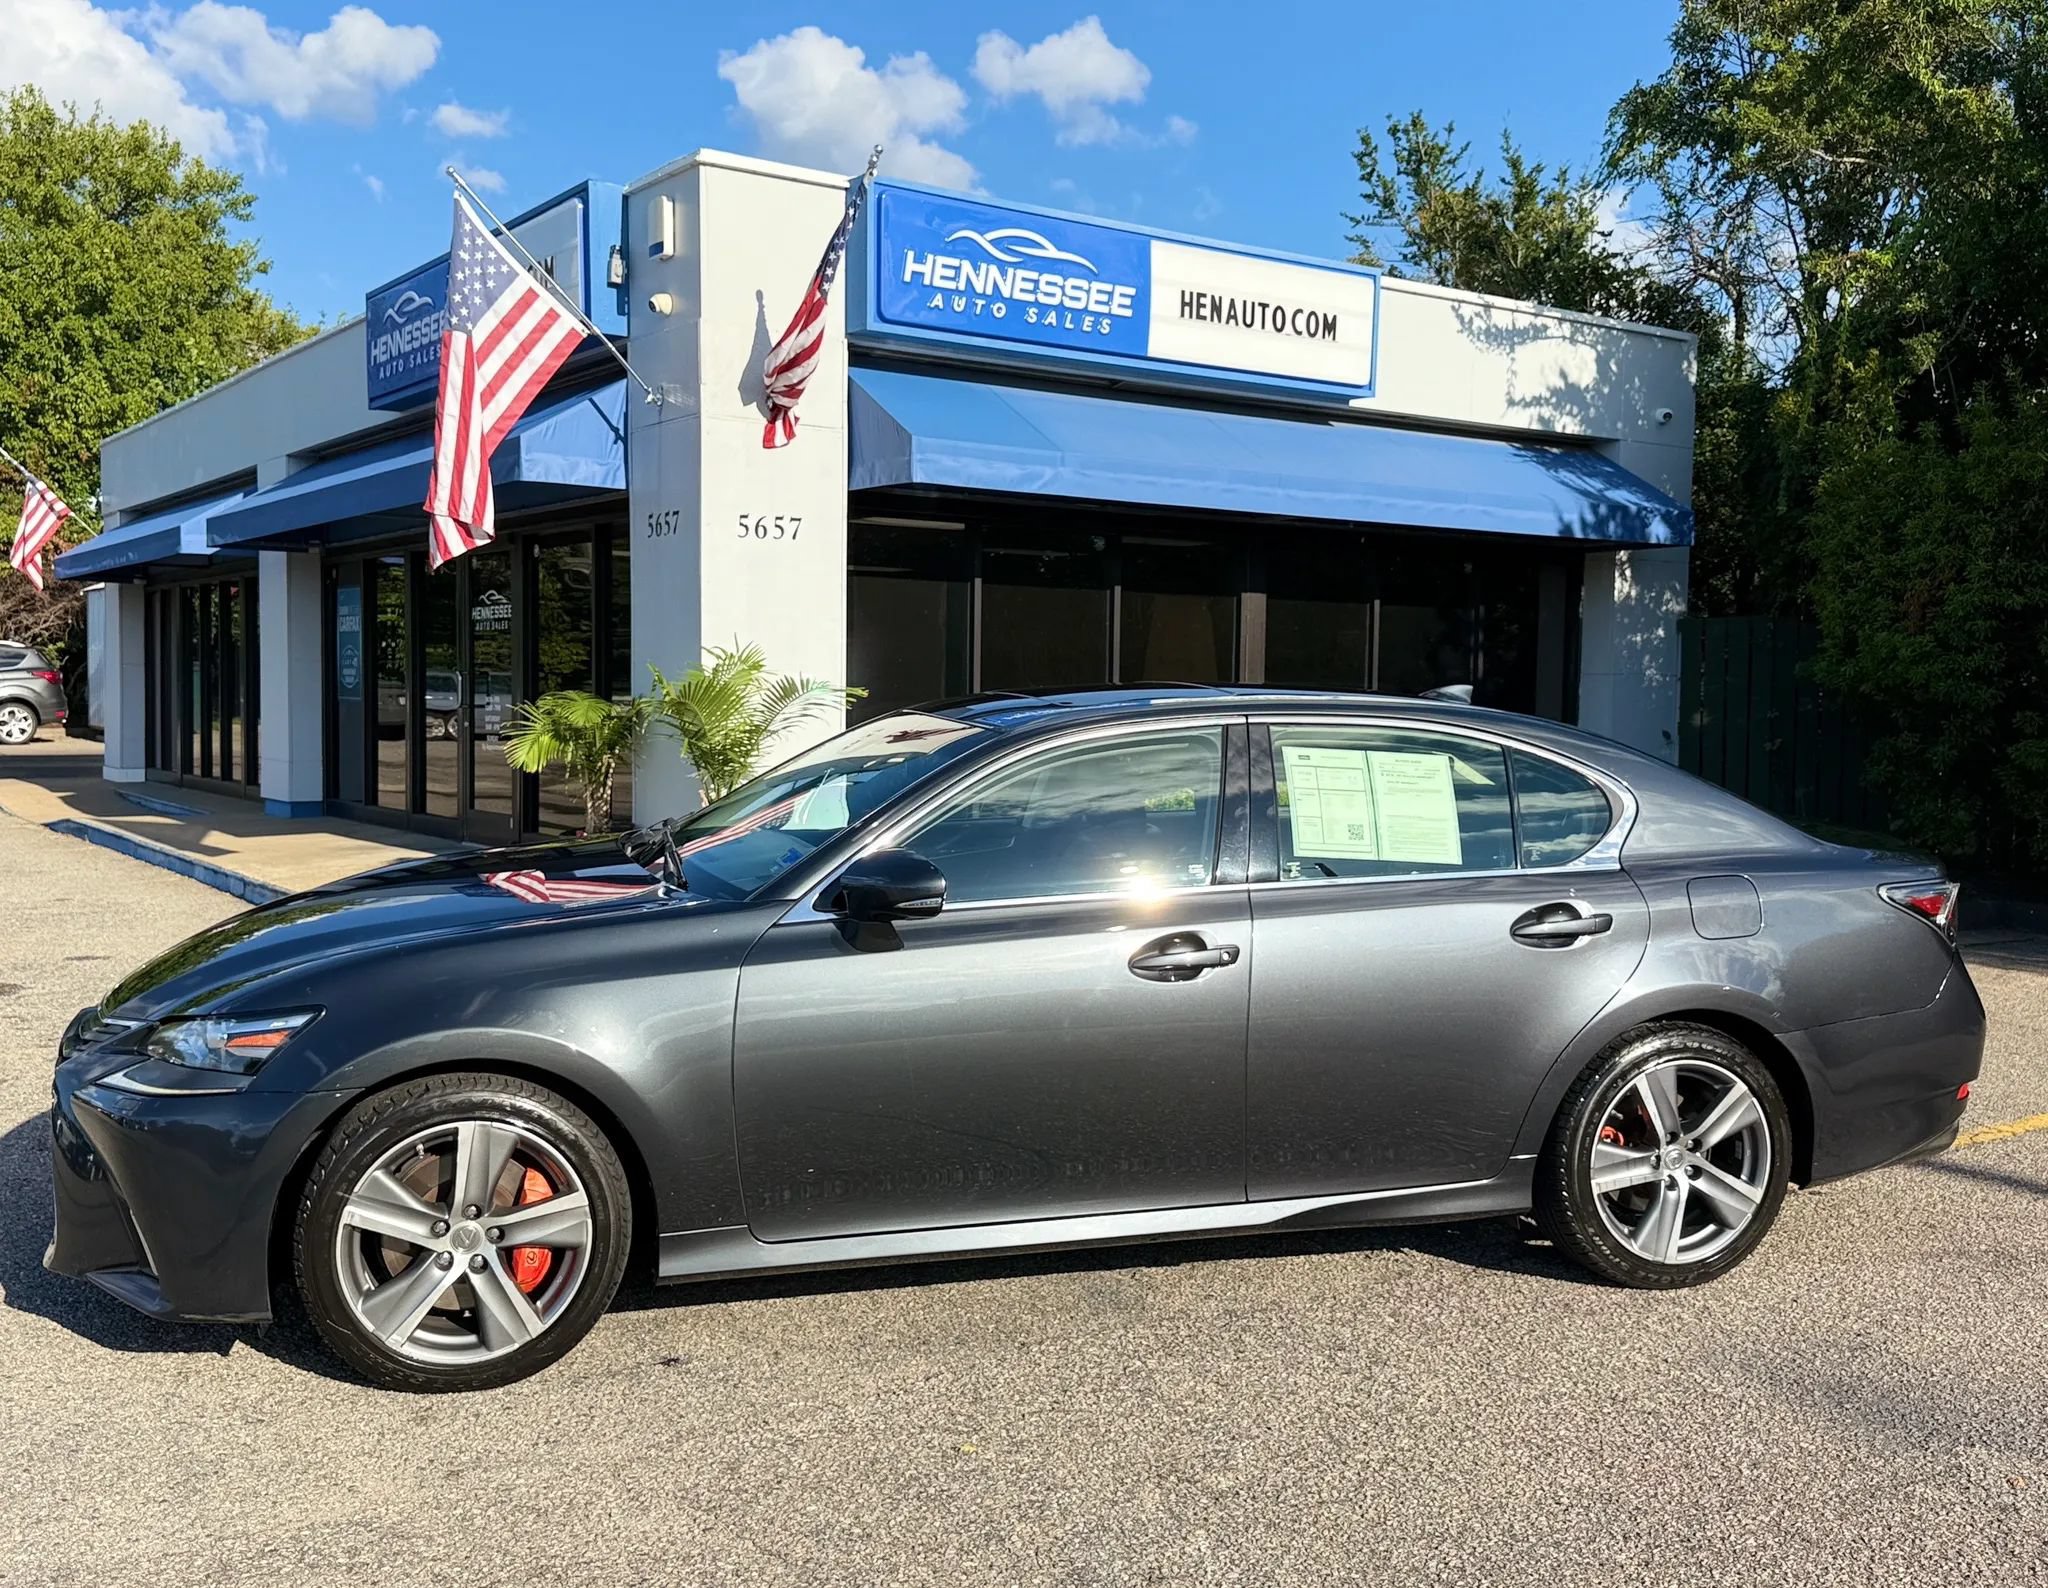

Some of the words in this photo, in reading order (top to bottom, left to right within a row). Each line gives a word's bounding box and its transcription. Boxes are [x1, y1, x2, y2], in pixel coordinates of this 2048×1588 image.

[903, 249, 1137, 318] HENNESSEE
[927, 292, 1007, 319] AUTO
[1025, 305, 1112, 335] SALES
[379, 358, 404, 379] AUTO
[409, 344, 441, 369] SALES
[647, 510, 680, 538] 5657
[737, 513, 802, 540] 5657
[471, 604, 512, 620] HENNESSEE
